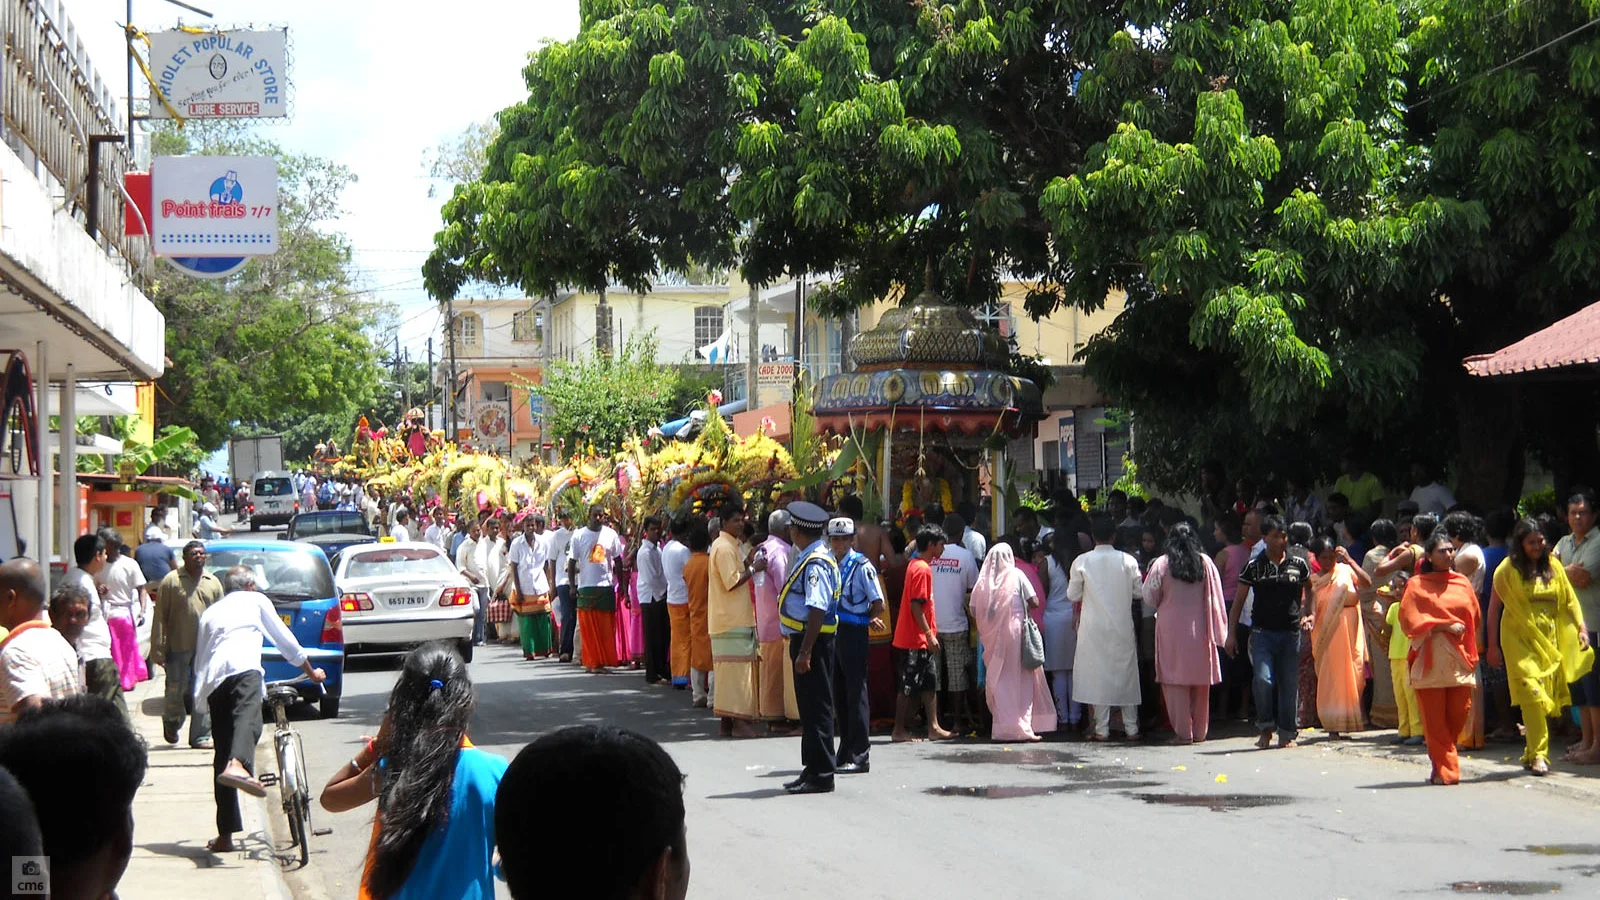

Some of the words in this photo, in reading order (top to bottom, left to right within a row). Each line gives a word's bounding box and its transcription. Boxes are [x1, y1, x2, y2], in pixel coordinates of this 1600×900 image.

[193, 36, 253, 60] POPULAR
[255, 59, 279, 104] STORE
[189, 103, 215, 115] LIBRE
[219, 103, 258, 115] SERVICE
[162, 199, 206, 218] Point
[208, 200, 247, 218] frais
[251, 206, 271, 219] 7/7
[758, 365, 775, 375] CADE
[776, 365, 793, 375] 2000
[929, 558, 958, 566] olgate
[936, 565, 961, 573] Herbal
